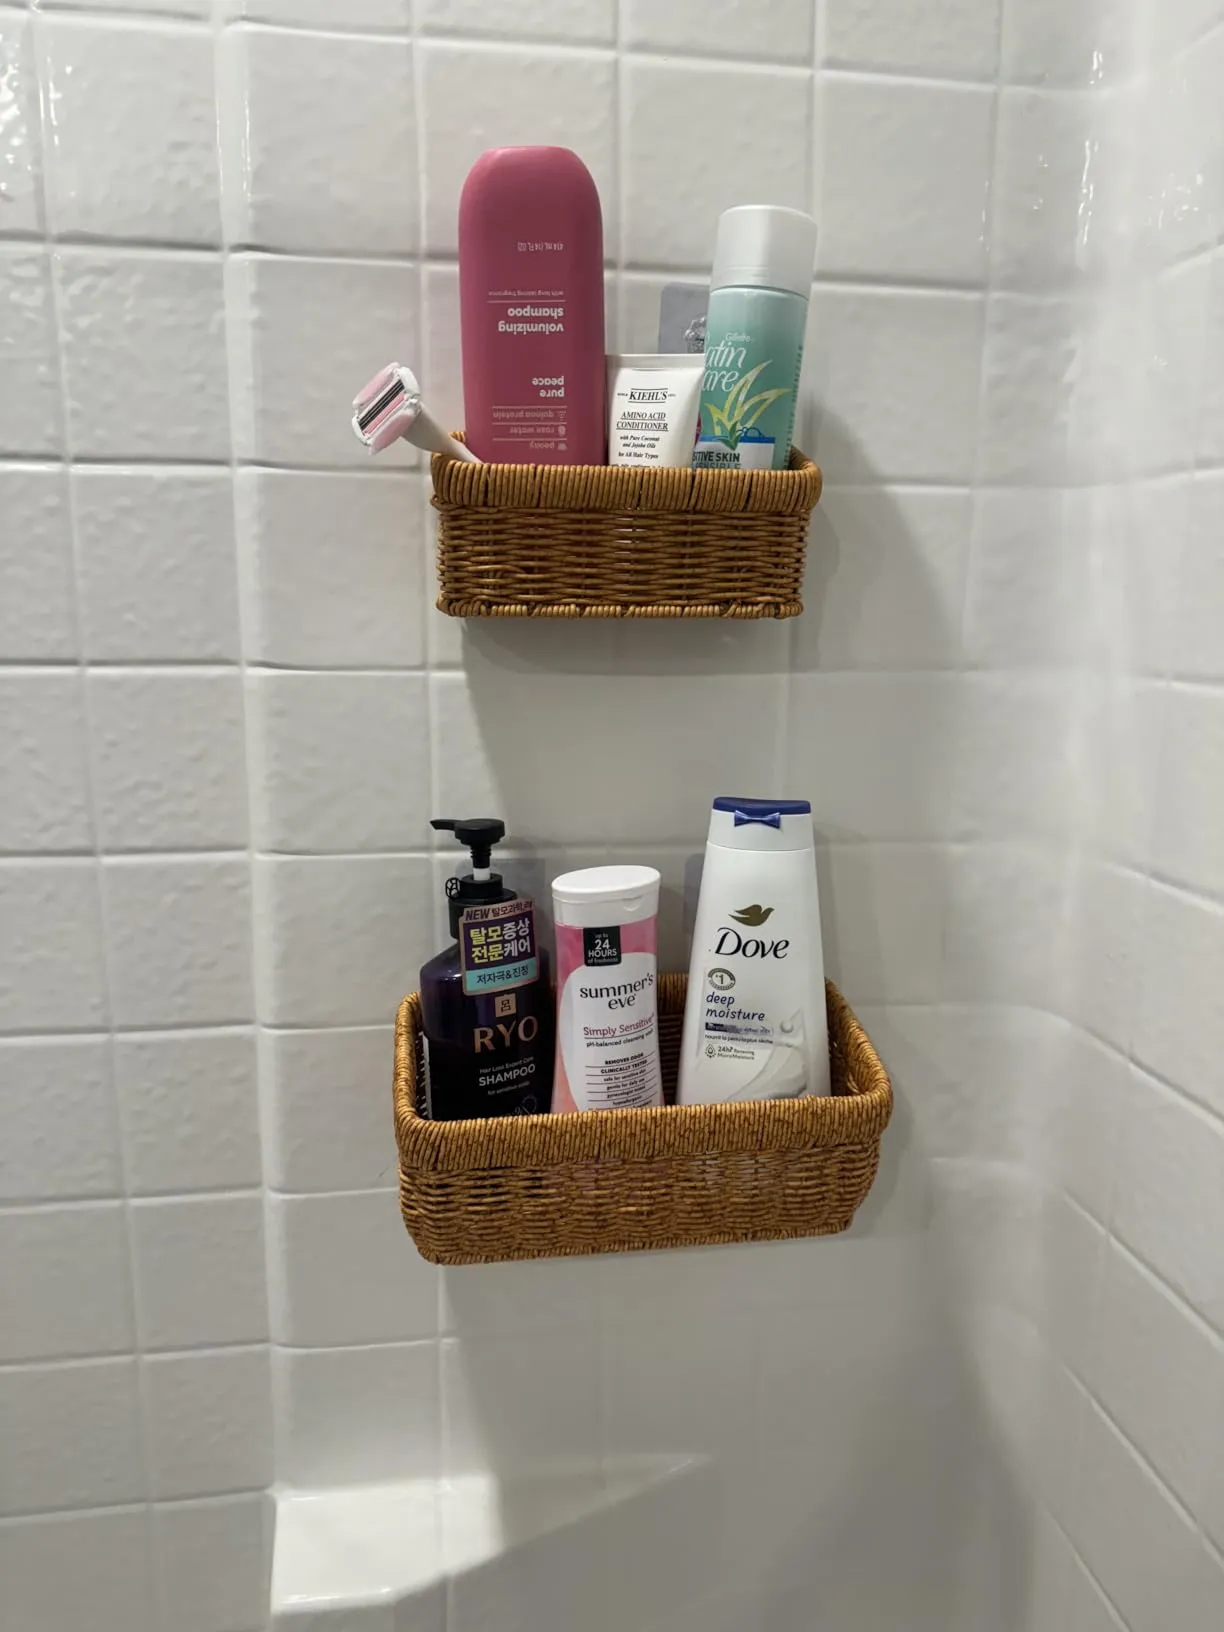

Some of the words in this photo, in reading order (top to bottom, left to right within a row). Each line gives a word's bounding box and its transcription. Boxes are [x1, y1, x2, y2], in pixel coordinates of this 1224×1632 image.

[507, 305, 564, 319] shampoo
[498, 321, 564, 335] volumizing
[705, 341, 747, 368] atin
[531, 376, 564, 386] peace
[701, 370, 739, 392] are
[539, 387, 565, 397] pure
[629, 391, 668, 401] KIEHL'S
[493, 410, 524, 419] protein
[525, 410, 555, 420] quinoa
[621, 411, 648, 419] AMINO
[648, 411, 666, 420] ACID
[616, 421, 669, 430] CONDITIONER
[529, 441, 555, 450] peony
[715, 451, 741, 462] SKIN
[465, 907, 490, 920] NEW
[469, 917, 530, 946] 탈모증상
[594, 939, 610, 950] 24
[714, 927, 790, 959] Dove
[471, 936, 531, 964] 전문케어
[588, 948, 617, 958] HOURS
[476, 964, 529, 985] 저자극&진정
[579, 972, 654, 999] summer's
[608, 996, 635, 1010] eve
[705, 991, 735, 1008] deep
[705, 1008, 765, 1022] moisture
[473, 1015, 539, 1054] RYO
[583, 1026, 617, 1037] Simply
[586, 1039, 622, 1048] pH-balanced
[623, 1035, 645, 1044] cleansing
[604, 1057, 630, 1065] REMOVES
[630, 1052, 644, 1061] ODOR
[600, 1065, 631, 1074] CLINICALLY
[632, 1059, 648, 1068] TESTED
[479, 1063, 536, 1087] SHAMPOO
